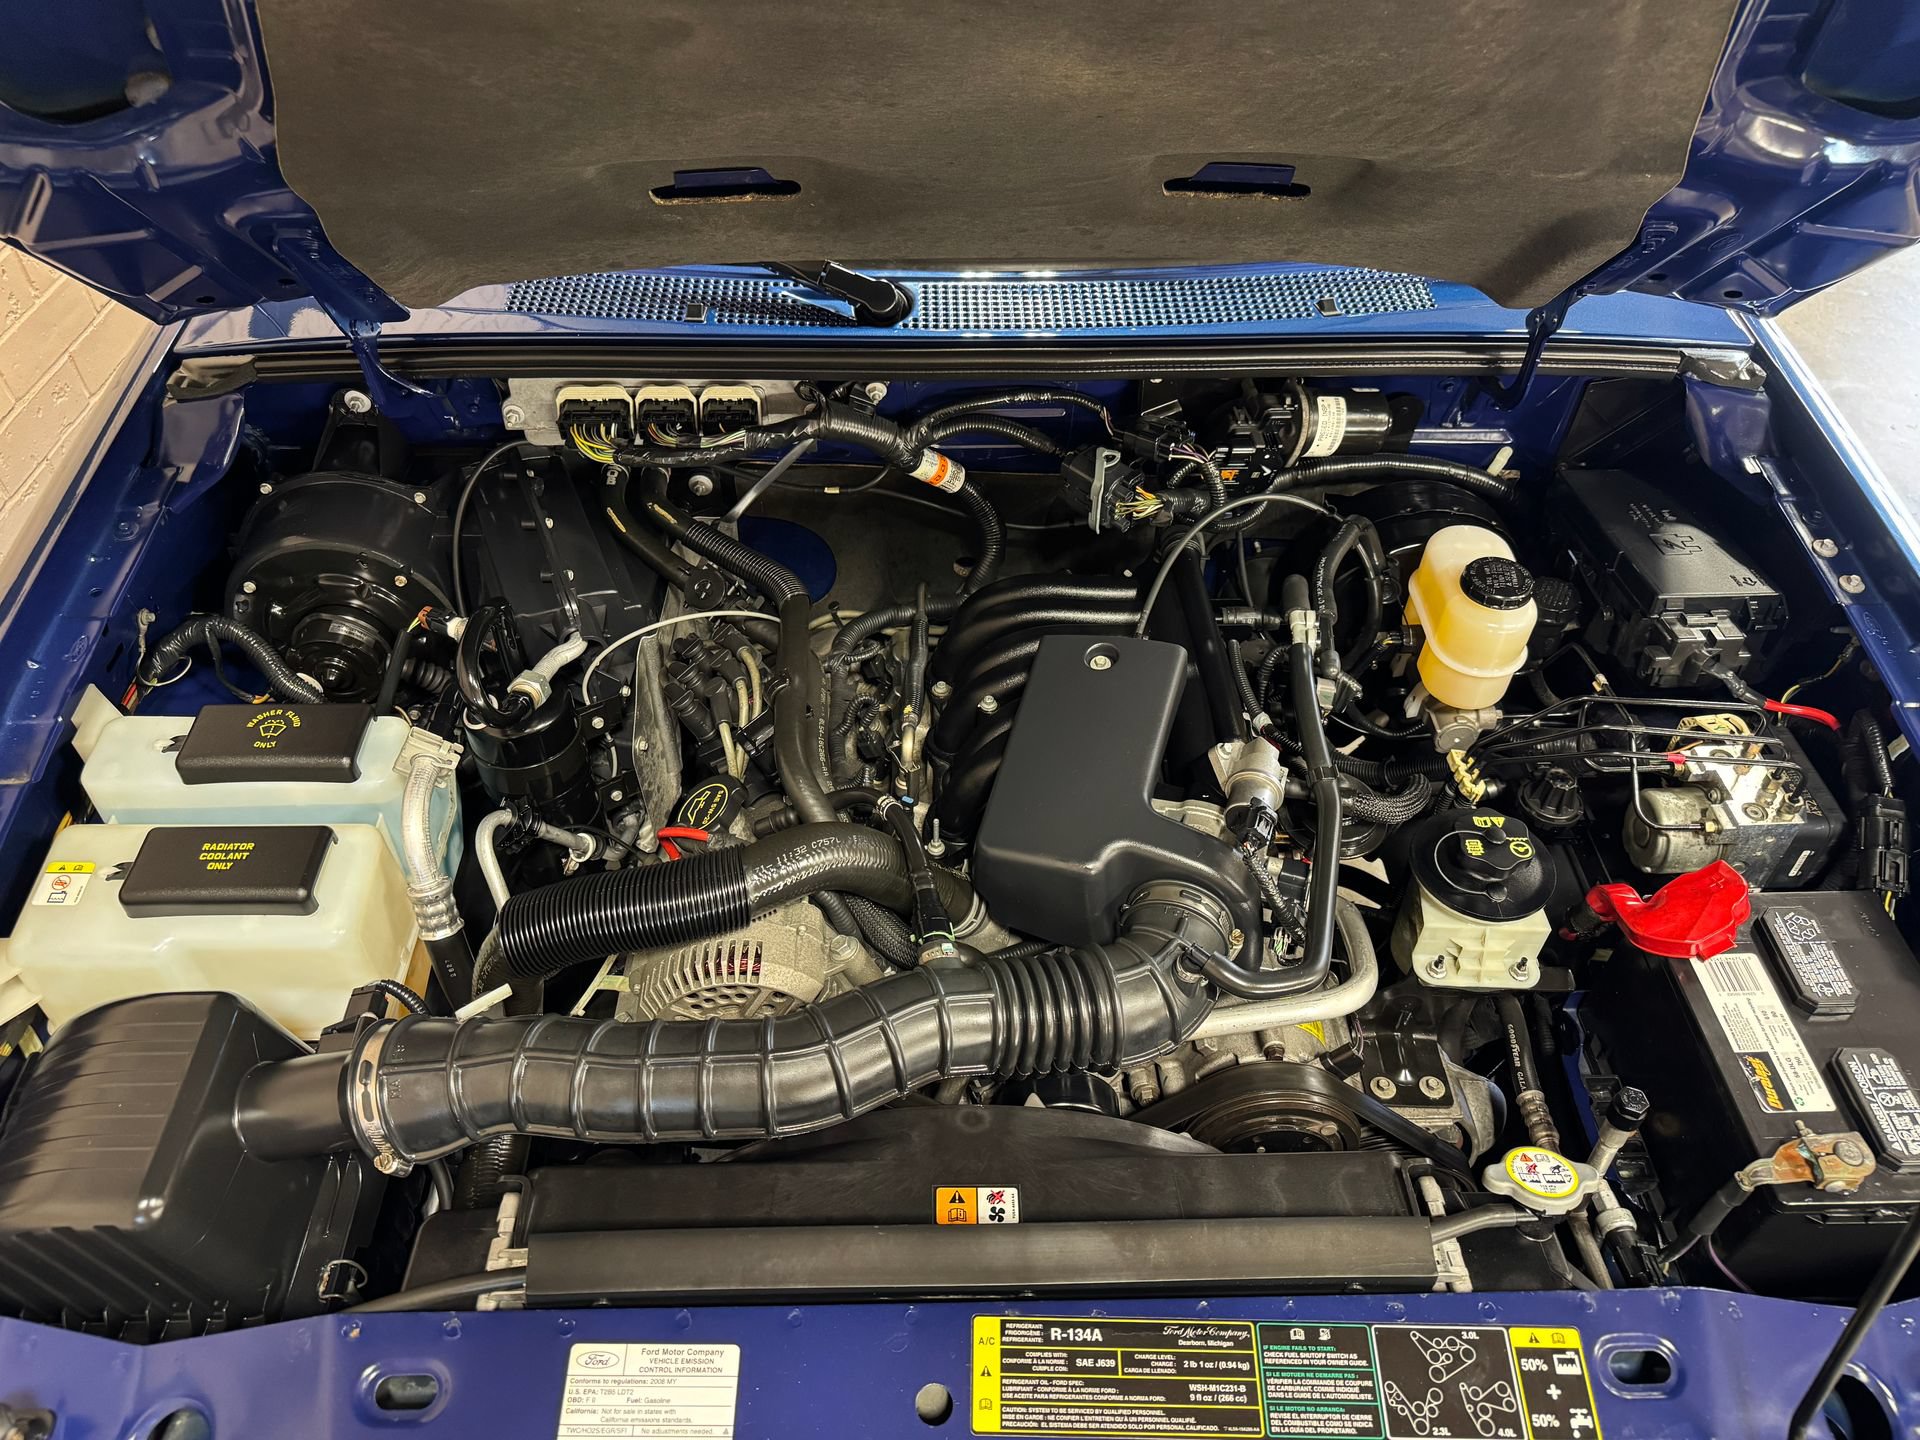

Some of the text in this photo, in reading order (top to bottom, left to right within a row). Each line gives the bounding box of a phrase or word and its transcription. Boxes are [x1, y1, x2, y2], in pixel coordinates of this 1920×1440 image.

[246, 710, 301, 727] WASHER FLUID
[702, 790, 724, 824] SAE 5W-20
[776, 844, 807, 865] 11:32
[1508, 1024, 1521, 1067] GOODYEAR
[1744, 1055, 1784, 1110] Duralast
[1848, 1061, 1872, 1095] POISON
[1870, 1103, 1898, 1141] DANGER
[1050, 1328, 1103, 1342] R-134A
[1163, 1326, 1184, 1336] Ford
[1180, 1326, 1208, 1338] Motor
[1461, 1331, 1479, 1340] 3.0L
[687, 1349, 724, 1357] Company
[585, 1354, 610, 1366] Ford
[1076, 1358, 1115, 1367] SAE J639
[1219, 1361, 1236, 1370] (0.94
[1237, 1362, 1250, 1370] kg)
[1520, 1358, 1549, 1372] 50%
[1189, 1384, 1246, 1393] WSH-M1C231-B
[1219, 1394, 1234, 1403] (266
[1532, 1413, 1560, 1428] 50%
[1432, 1427, 1451, 1436] 2.3L
[1498, 1428, 1516, 1437] 4.0L
